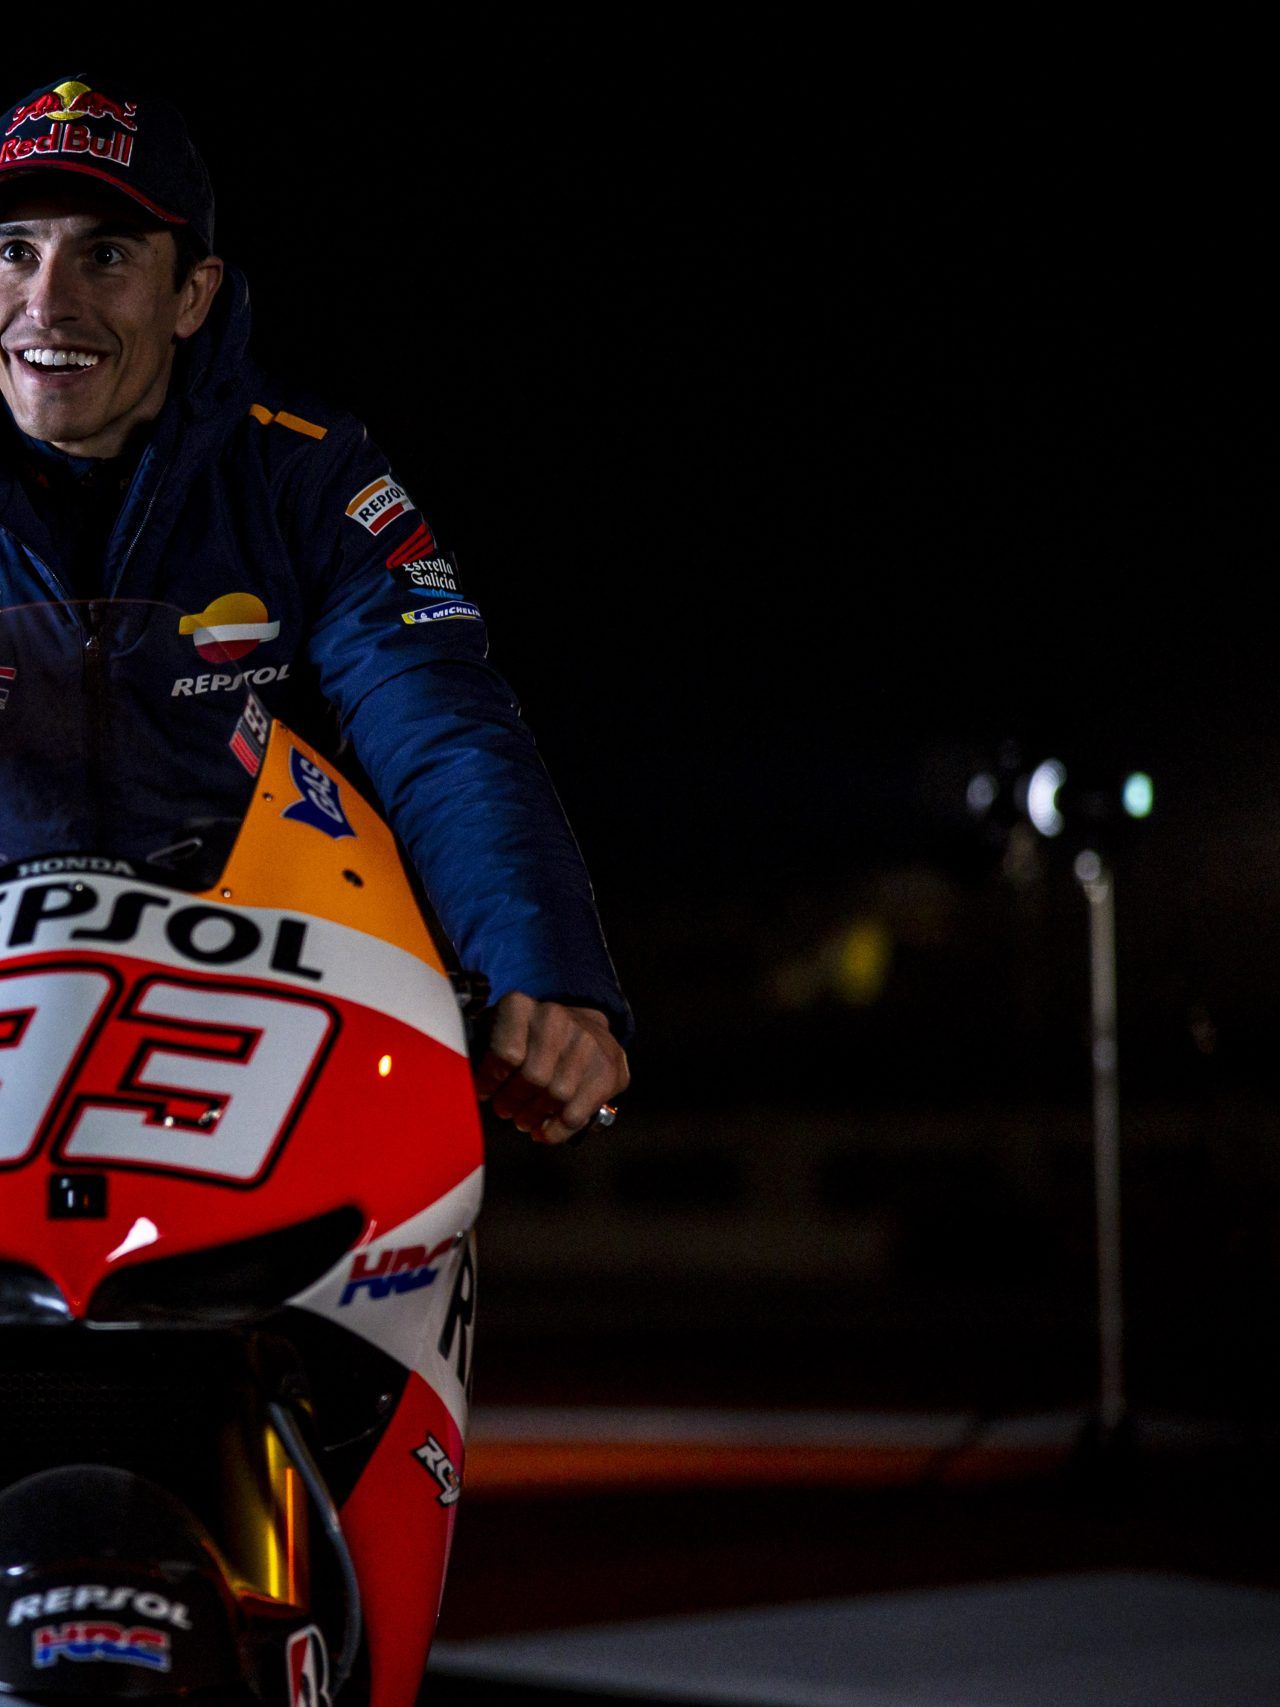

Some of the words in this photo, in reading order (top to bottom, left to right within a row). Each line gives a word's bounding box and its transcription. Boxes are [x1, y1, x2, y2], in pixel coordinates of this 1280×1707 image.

[62, 123, 134, 167] Bull
[358, 486, 405, 522] REPSOL
[402, 559, 454, 575] Estrella
[410, 571, 457, 590] Galicia
[432, 606, 481, 619] MICHELIN
[171, 664, 291, 697] REPSOL
[243, 693, 269, 745] 93
[300, 758, 344, 824] GAS
[18, 856, 137, 878] HONDA
[338, 1237, 455, 1308] HRC
[6, 1584, 192, 1630] REPSOL
[31, 1621, 172, 1673] HRC
